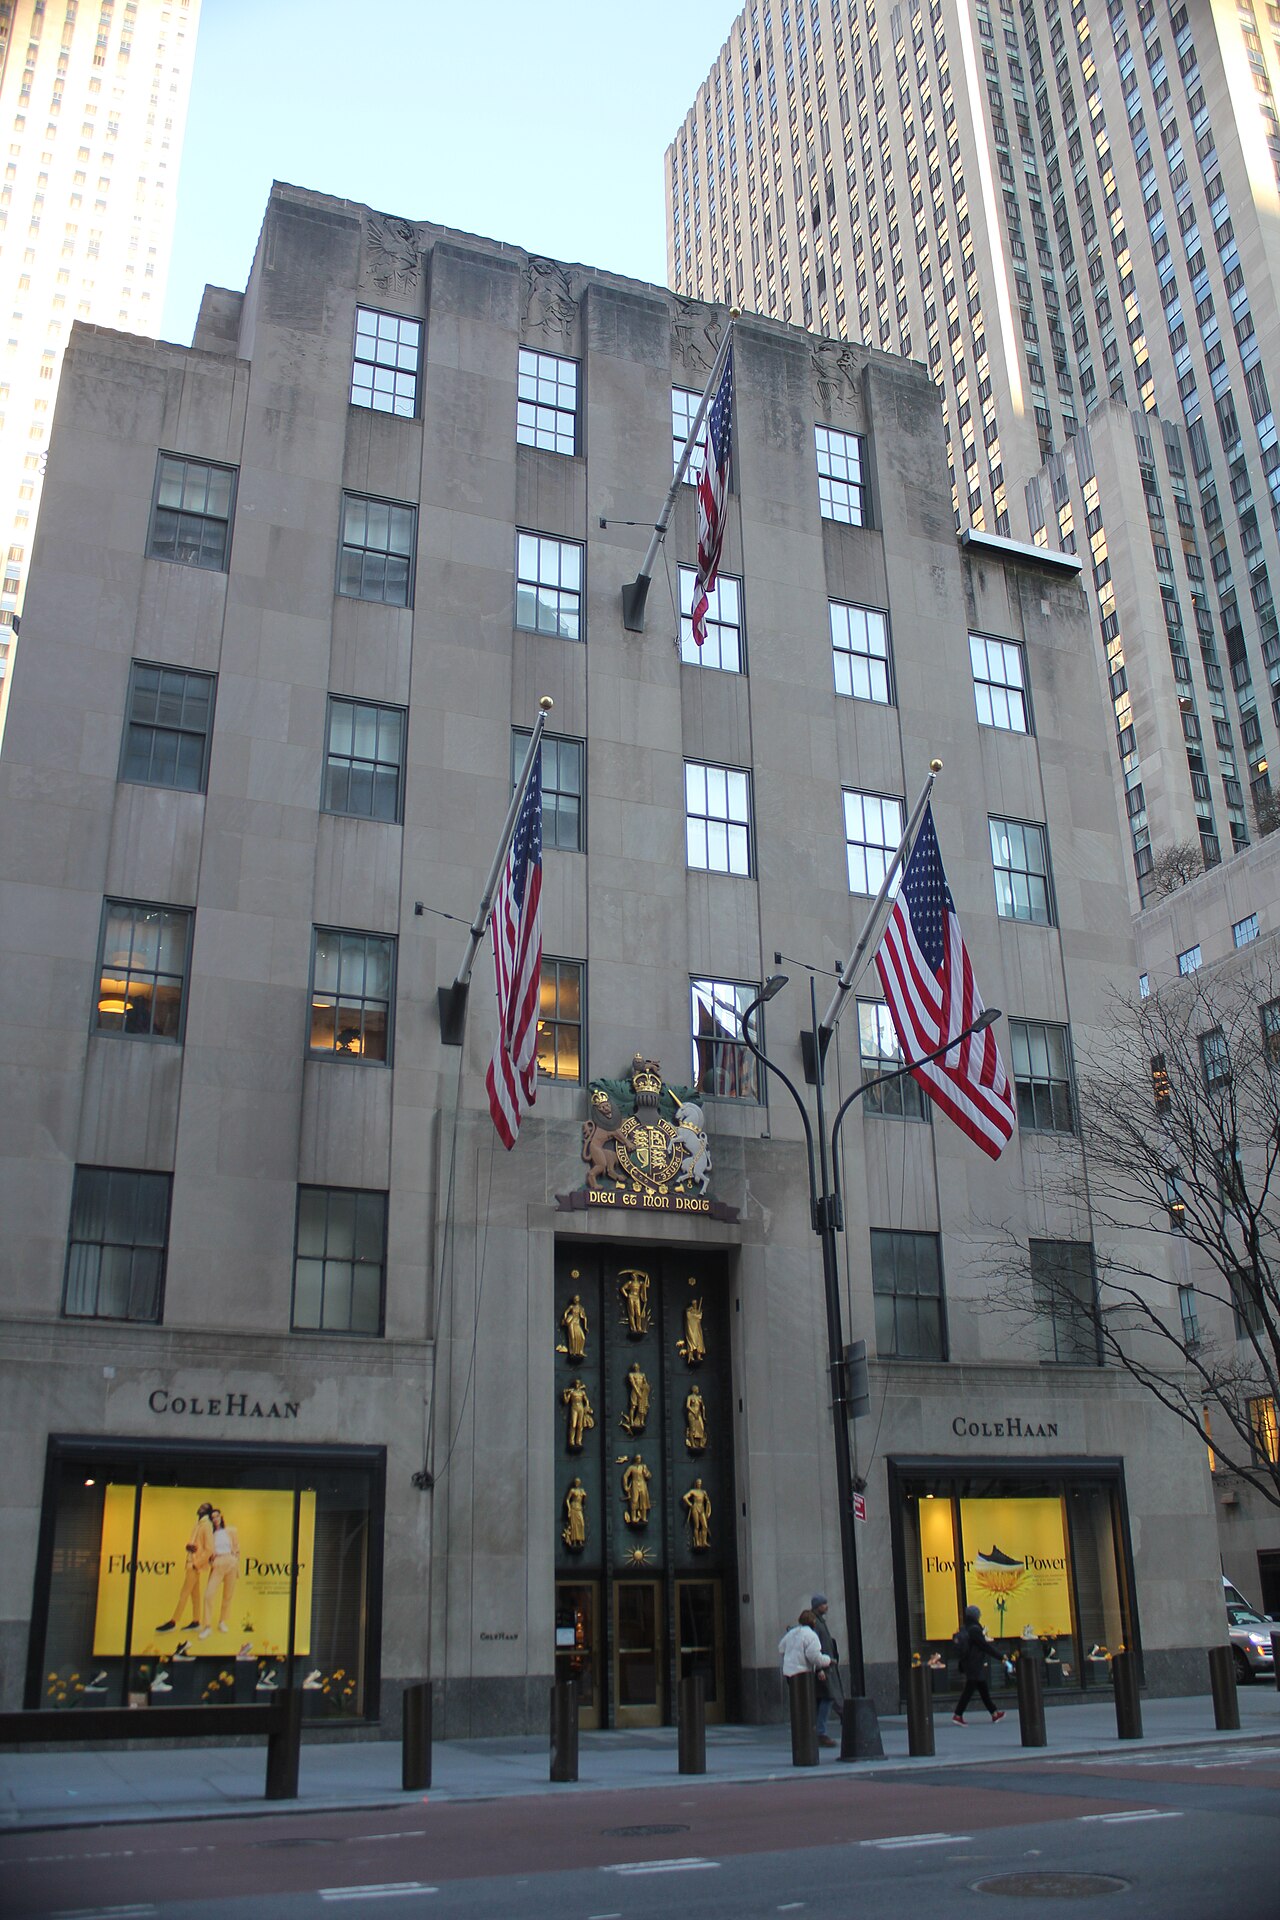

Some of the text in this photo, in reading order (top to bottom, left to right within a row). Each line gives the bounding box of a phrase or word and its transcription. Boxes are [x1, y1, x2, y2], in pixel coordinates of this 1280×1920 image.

[621, 1119, 638, 1135] SOIT
[660, 1157, 681, 1180] PENSE
[589, 1191, 710, 1210] DIEU ET MON DROIT
[926, 1555, 1065, 1573] Flowr Power
